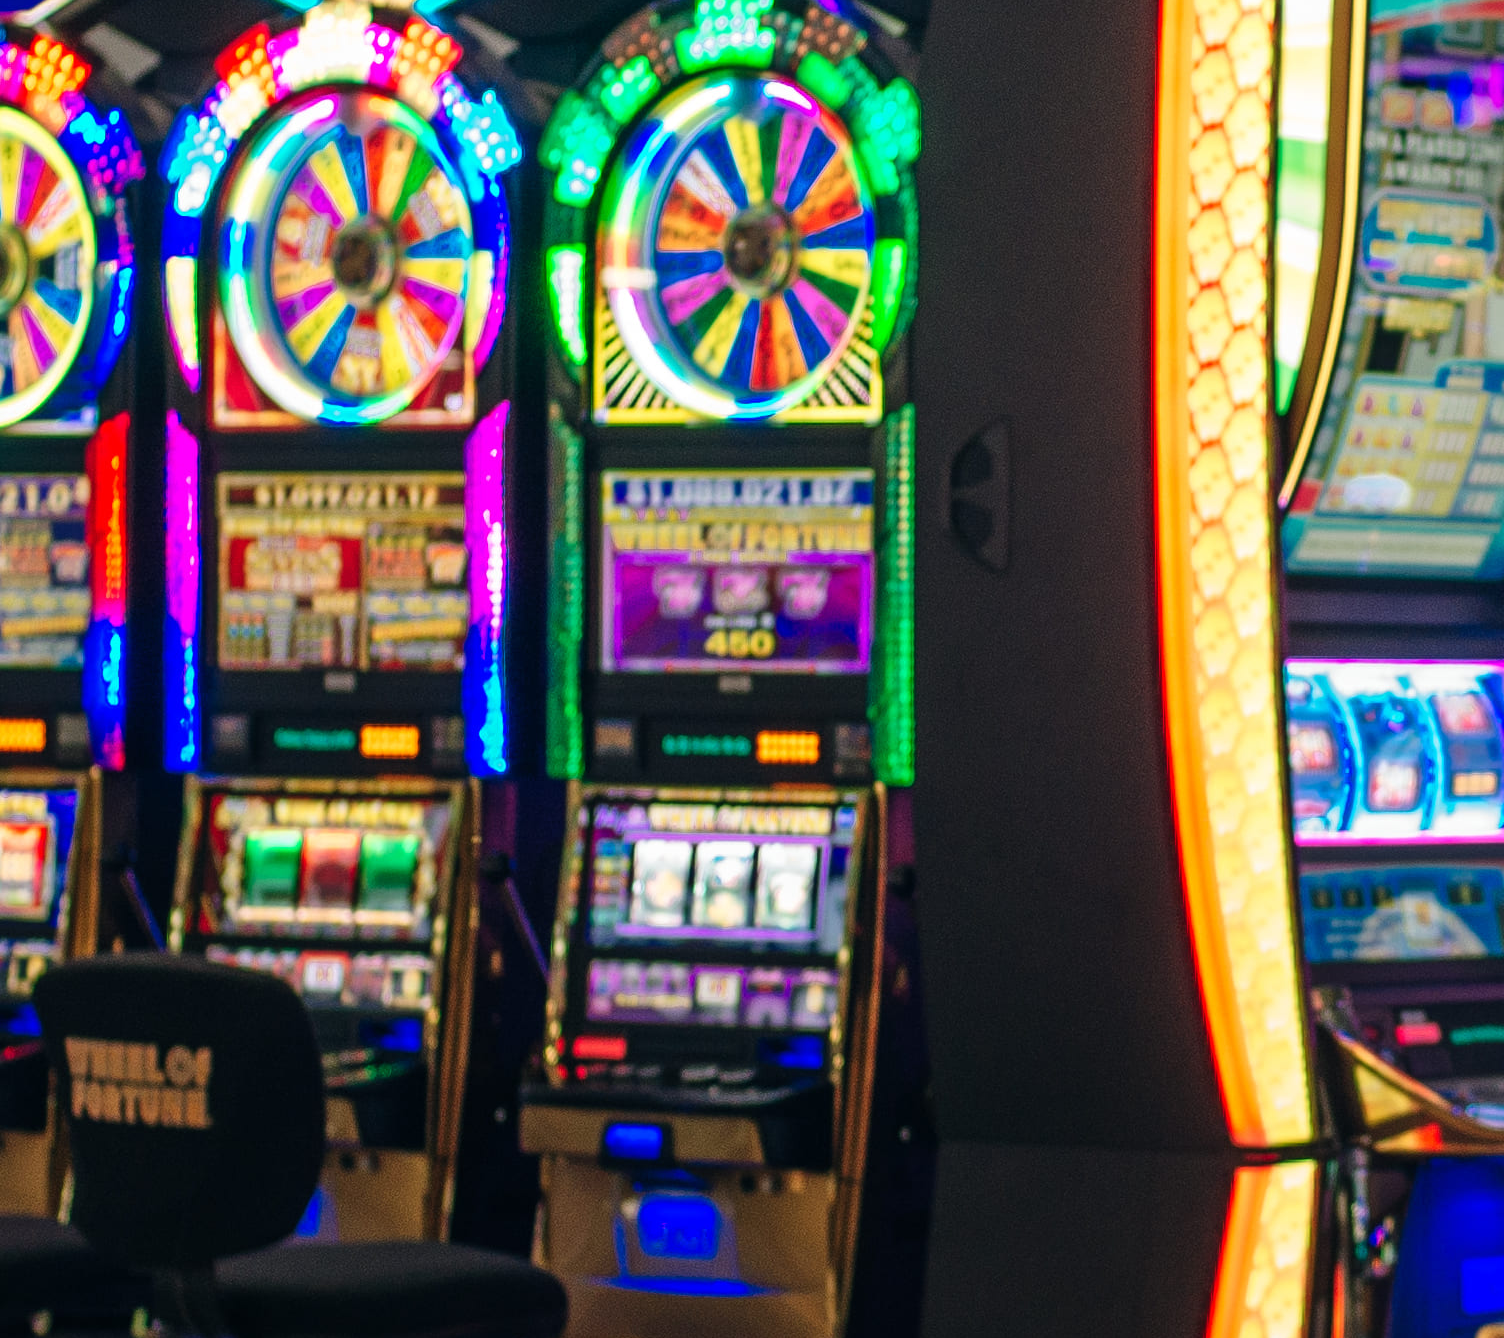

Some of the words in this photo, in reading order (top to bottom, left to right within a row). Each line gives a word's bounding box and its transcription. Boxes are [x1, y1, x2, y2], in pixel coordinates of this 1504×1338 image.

[704, 628, 776, 659] 450
[64, 1036, 165, 1083] WHEEL
[165, 1045, 213, 1088] OF
[70, 1079, 214, 1130] FORTUNE
